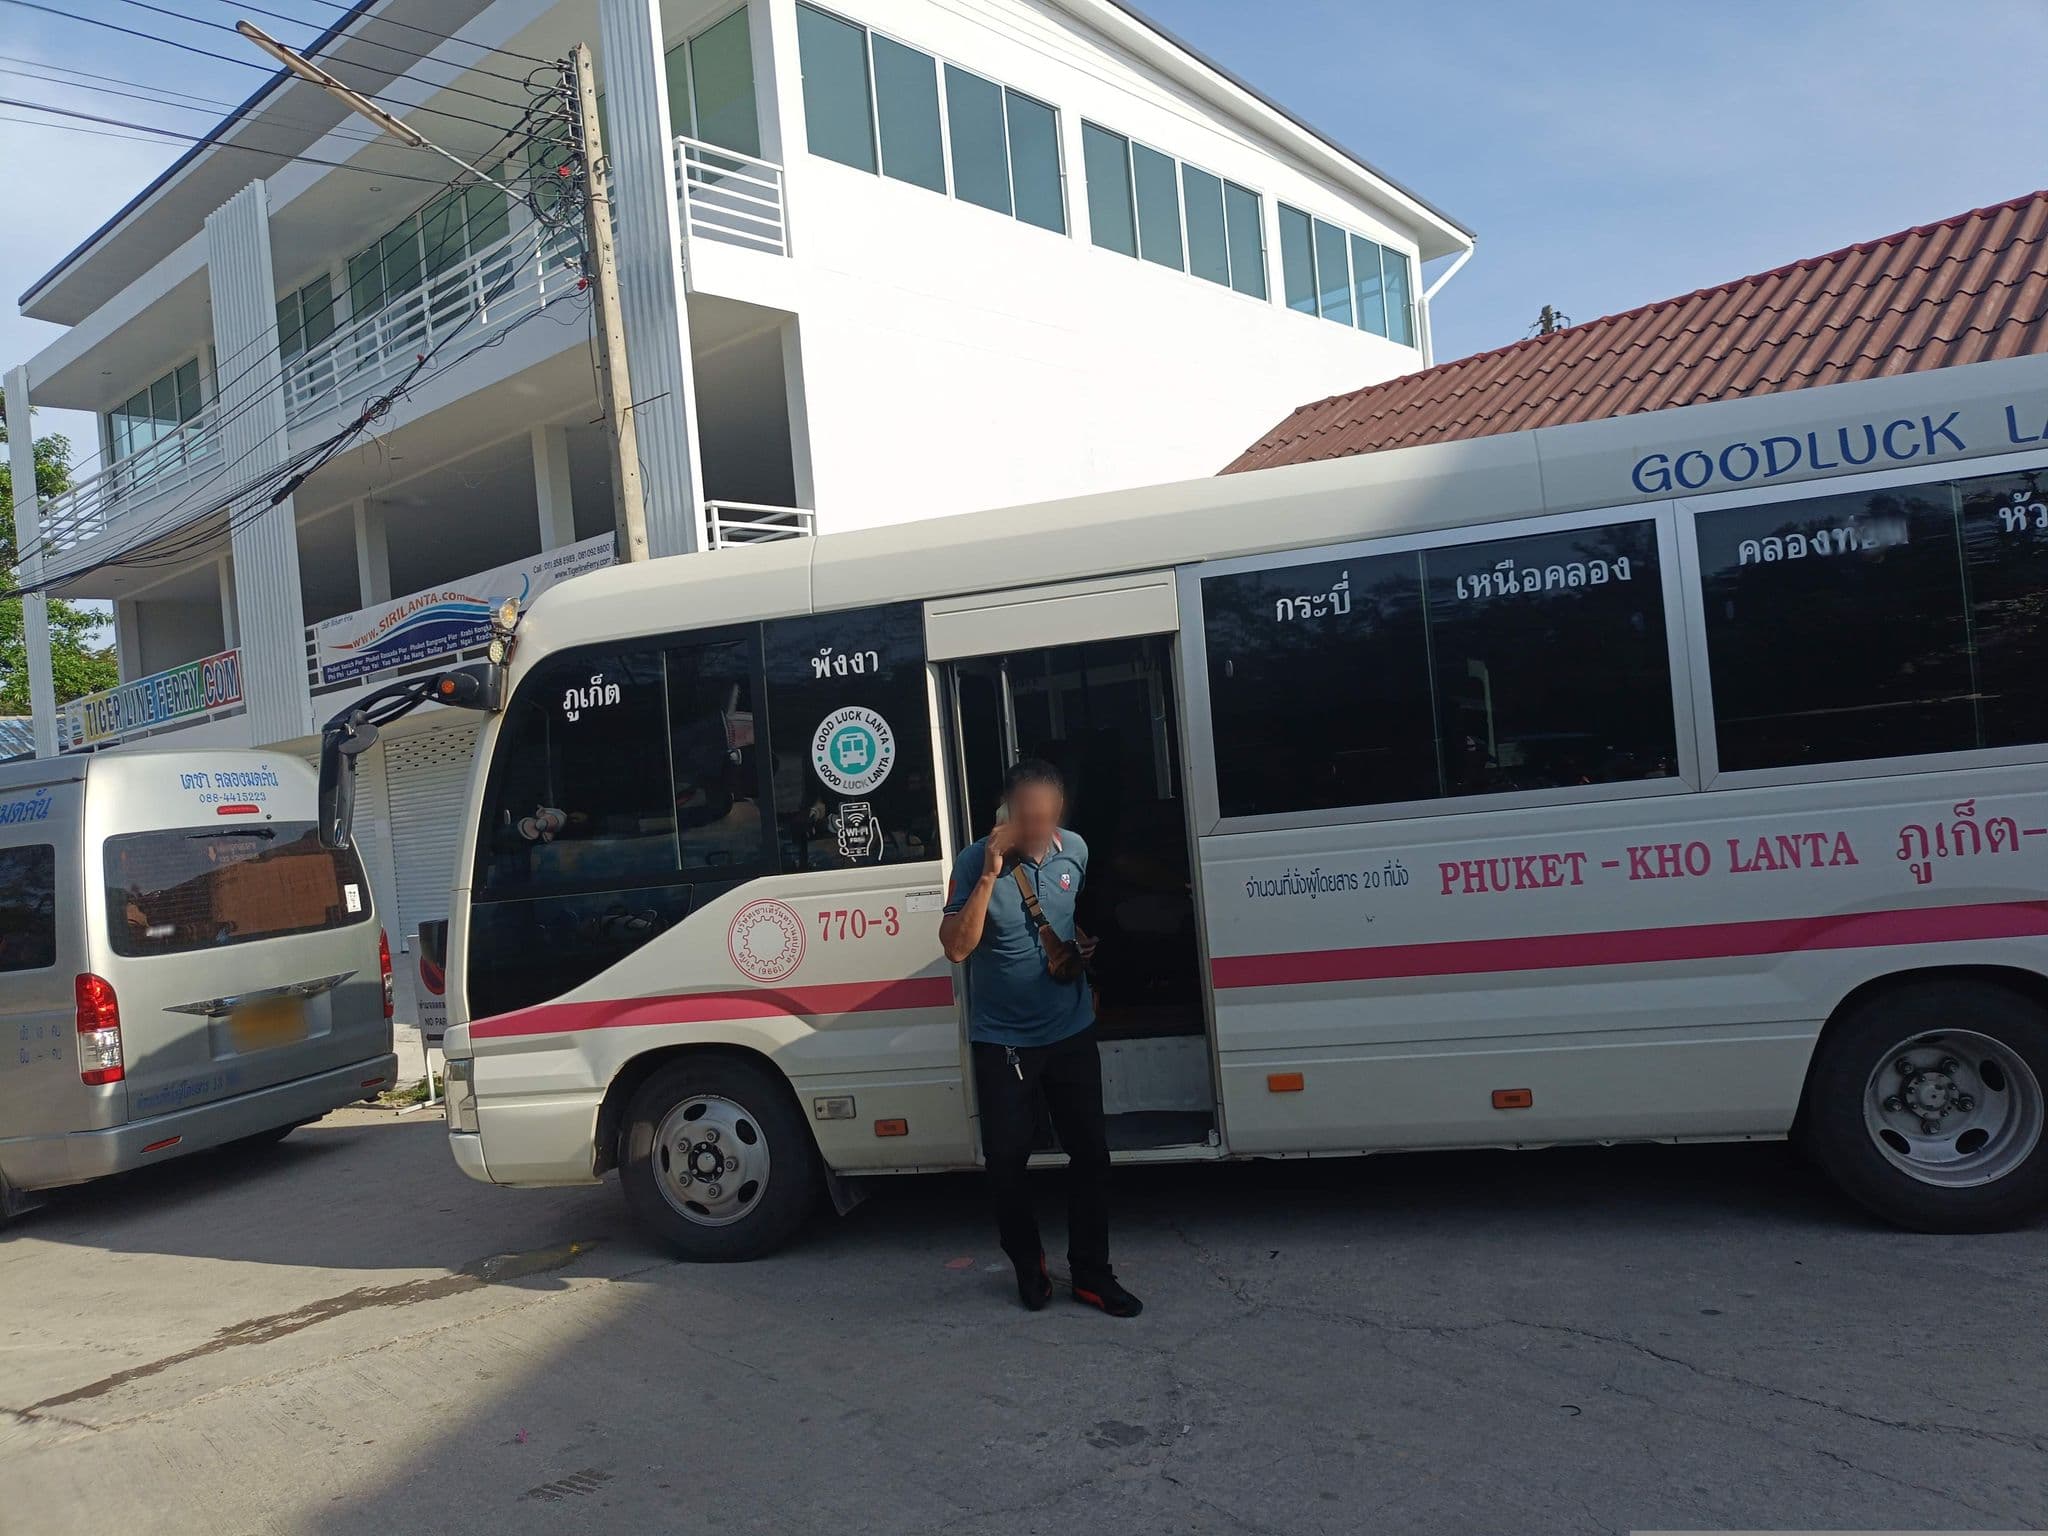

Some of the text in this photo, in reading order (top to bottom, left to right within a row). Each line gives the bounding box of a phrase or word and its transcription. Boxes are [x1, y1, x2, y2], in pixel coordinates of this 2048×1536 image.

[1631, 405, 2048, 493] GOODLUCK L
[1276, 571, 1351, 622] กระบี่
[1456, 555, 1632, 600] เหนือคลอง
[811, 647, 879, 679] พังงา
[86, 655, 240, 737] TIGER LINE FERRY.COM
[563, 673, 621, 722] ภูเก็ต
[816, 710, 890, 751] GOOD LUCK LANTA
[180, 771, 211, 789] เดชา
[820, 764, 841, 786] GOOD
[867, 756, 890, 784] LANTA
[199, 792, 267, 803] 088-4415223
[1246, 858, 1409, 900] จำนวนที่นั่งผู้โดยสาร 20 ที่นั่ง
[1438, 852, 1588, 895] PHUKET
[1626, 841, 1712, 881] KHO
[1726, 831, 1859, 873] LANTA
[818, 906, 900, 941] 770-3
